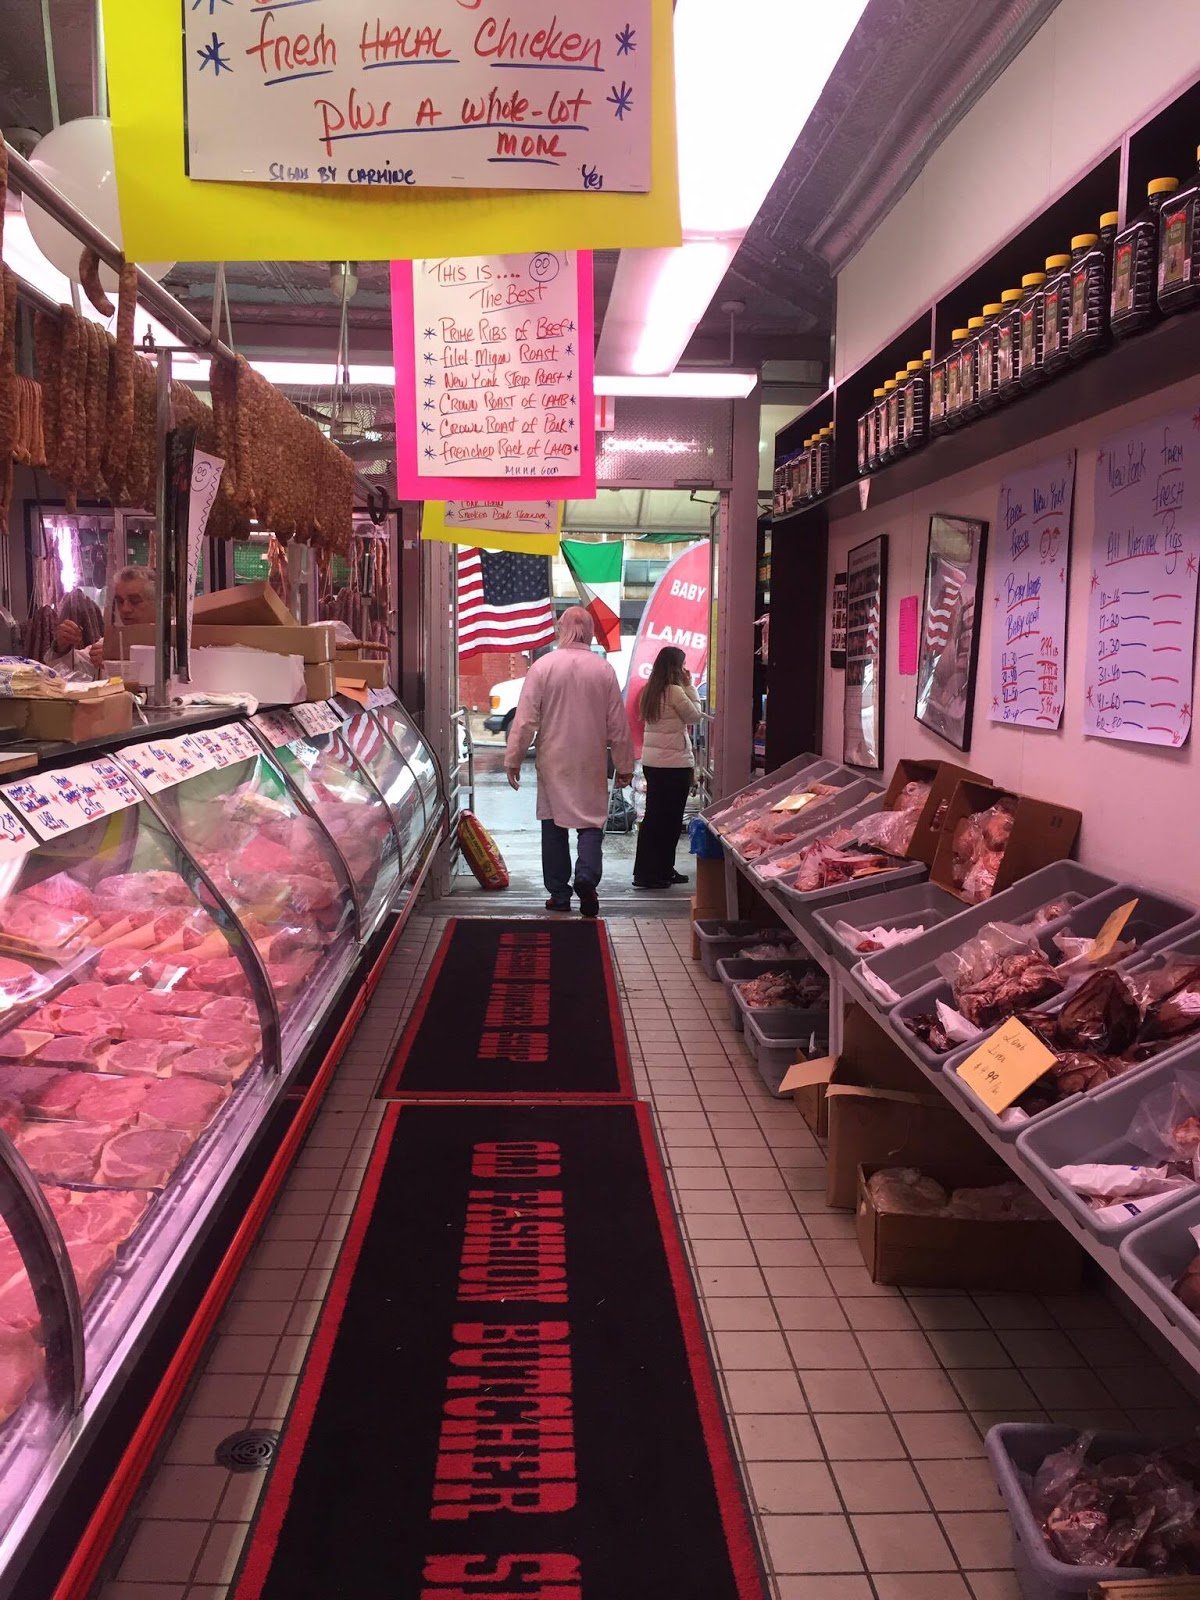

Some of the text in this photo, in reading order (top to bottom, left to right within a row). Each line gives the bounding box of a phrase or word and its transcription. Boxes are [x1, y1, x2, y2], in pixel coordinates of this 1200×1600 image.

[360, 18, 452, 62] HALAL
[474, 15, 601, 69] Chicken
[416, 98, 442, 127] A
[317, 166, 337, 182] BY
[428, 258, 467, 282] THIS
[469, 284, 502, 308] The
[445, 372, 468, 388] New
[670, 579, 707, 602] BABY
[645, 621, 707, 650] LAMB
[470, 1141, 562, 1178] OLD
[455, 1189, 570, 1304] FASHION
[428, 1320, 578, 1521] BUTCHER
